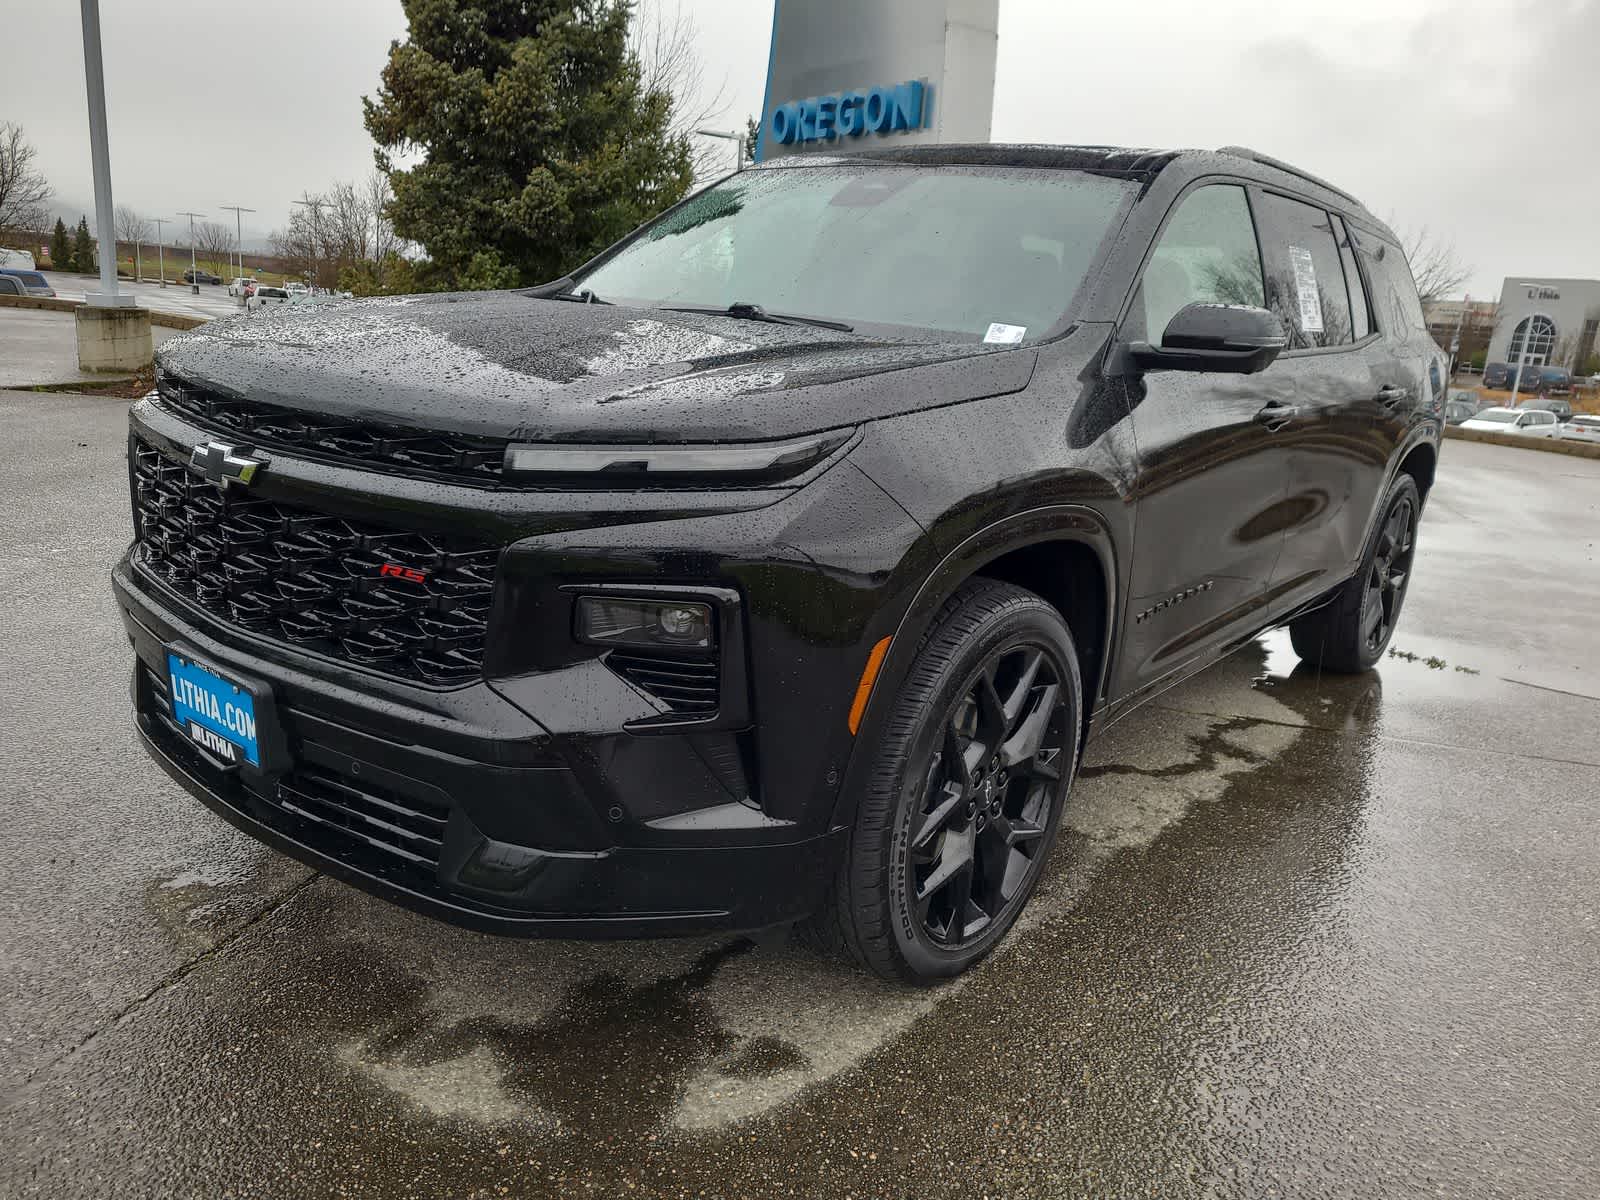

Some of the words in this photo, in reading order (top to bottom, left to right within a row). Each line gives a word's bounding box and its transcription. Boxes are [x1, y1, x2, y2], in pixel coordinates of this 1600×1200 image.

[771, 80, 923, 144] OREGON
[380, 562, 425, 584] RS
[171, 674, 256, 741] LITHIA.COM
[199, 727, 236, 761] LITHIA
